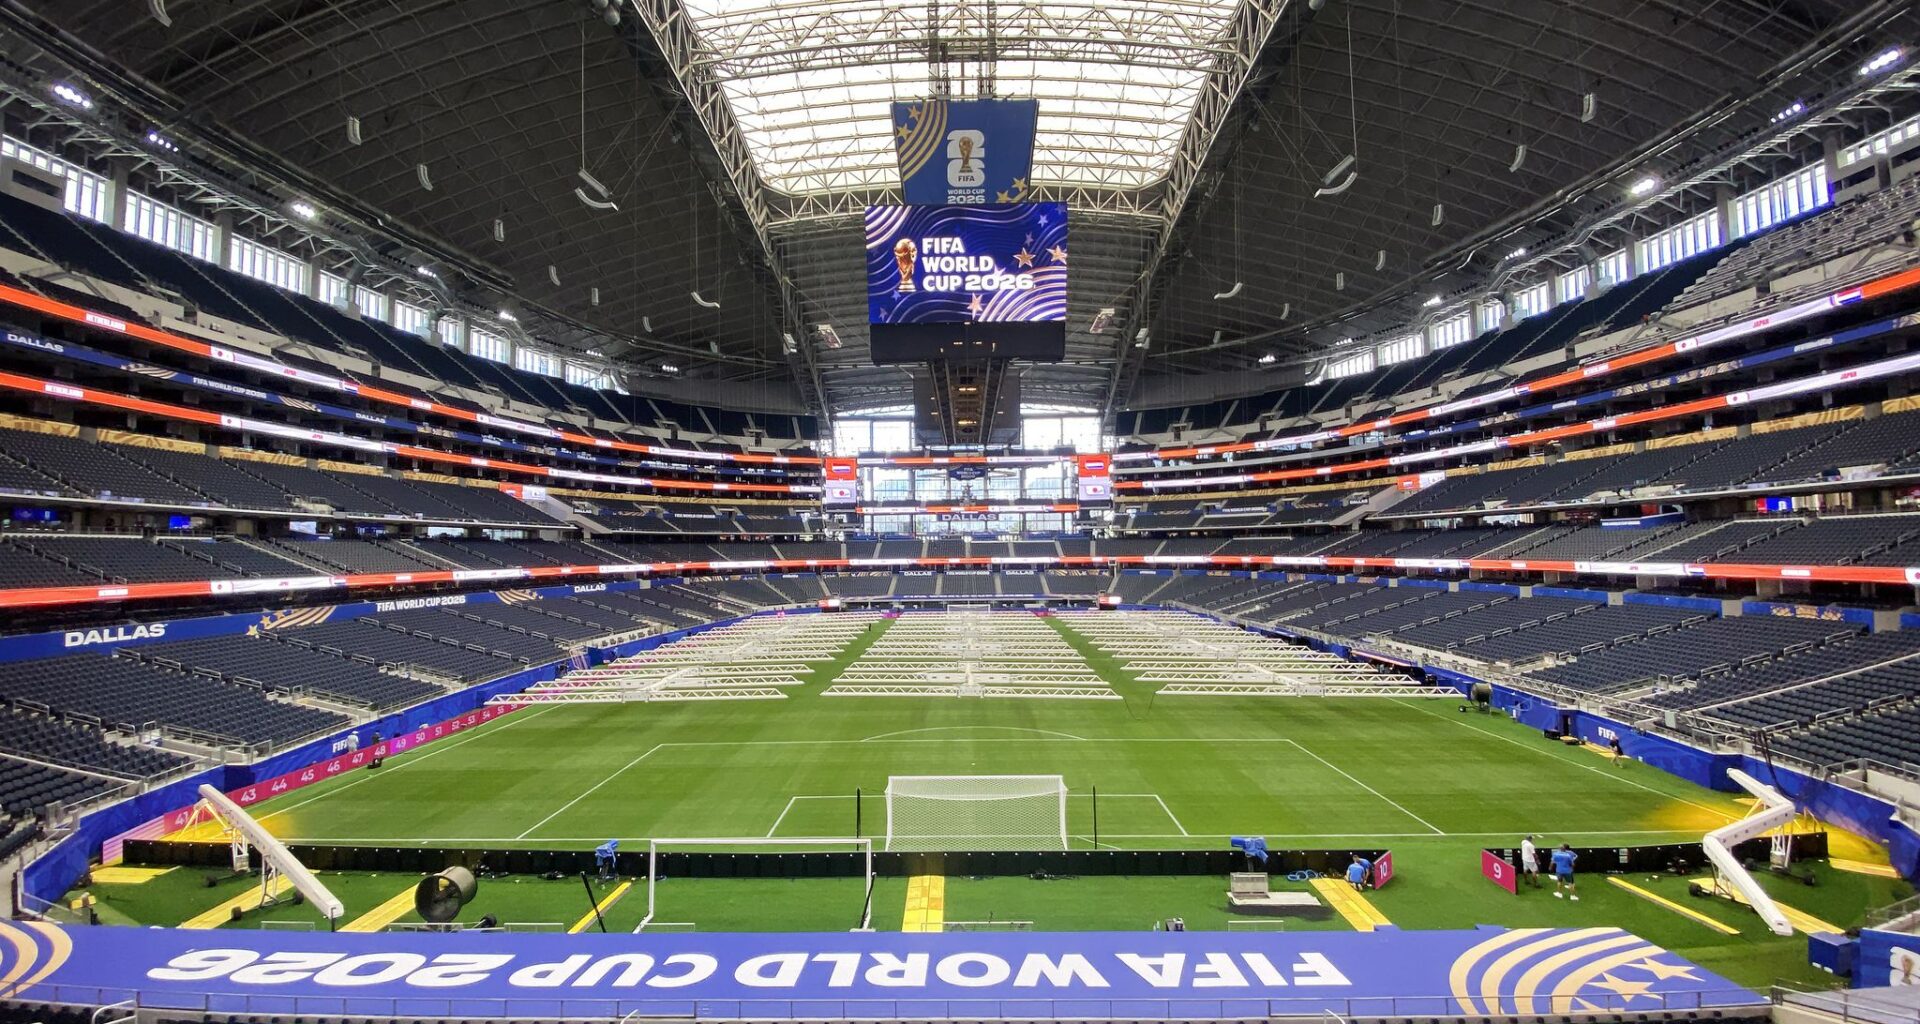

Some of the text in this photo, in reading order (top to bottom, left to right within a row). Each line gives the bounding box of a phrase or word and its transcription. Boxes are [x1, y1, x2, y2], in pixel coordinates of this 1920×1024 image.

[947, 195, 986, 205] 2026
[922, 237, 965, 254] FIFA
[921, 256, 994, 273] WORLD
[922, 274, 1034, 292] CUP 2026
[8, 334, 64, 353] DALLAS
[193, 377, 209, 387] FIFA
[208, 380, 232, 391] WORLD
[355, 412, 386, 424] DALLAS
[941, 513, 997, 521] DALLAS
[574, 583, 606, 593] DALLAS
[376, 595, 466, 613] FIFA WORLD CUP 2026
[65, 624, 166, 647] DALLAS
[467, 715, 476, 725] 53
[482, 710, 490, 720] 54
[416, 732, 426, 743] 50
[435, 726, 442, 736] 51
[396, 738, 407, 749] 49
[374, 745, 386, 756] 48
[352, 752, 364, 764] 47
[327, 760, 340, 773] 46
[301, 769, 315, 782] 45
[271, 778, 287, 792] 44
[241, 788, 257, 802] 43
[1379, 863, 1388, 879] 10
[1493, 862, 1502, 879] 9
[147, 948, 1353, 988] FIFA WORLD CUP 2026
